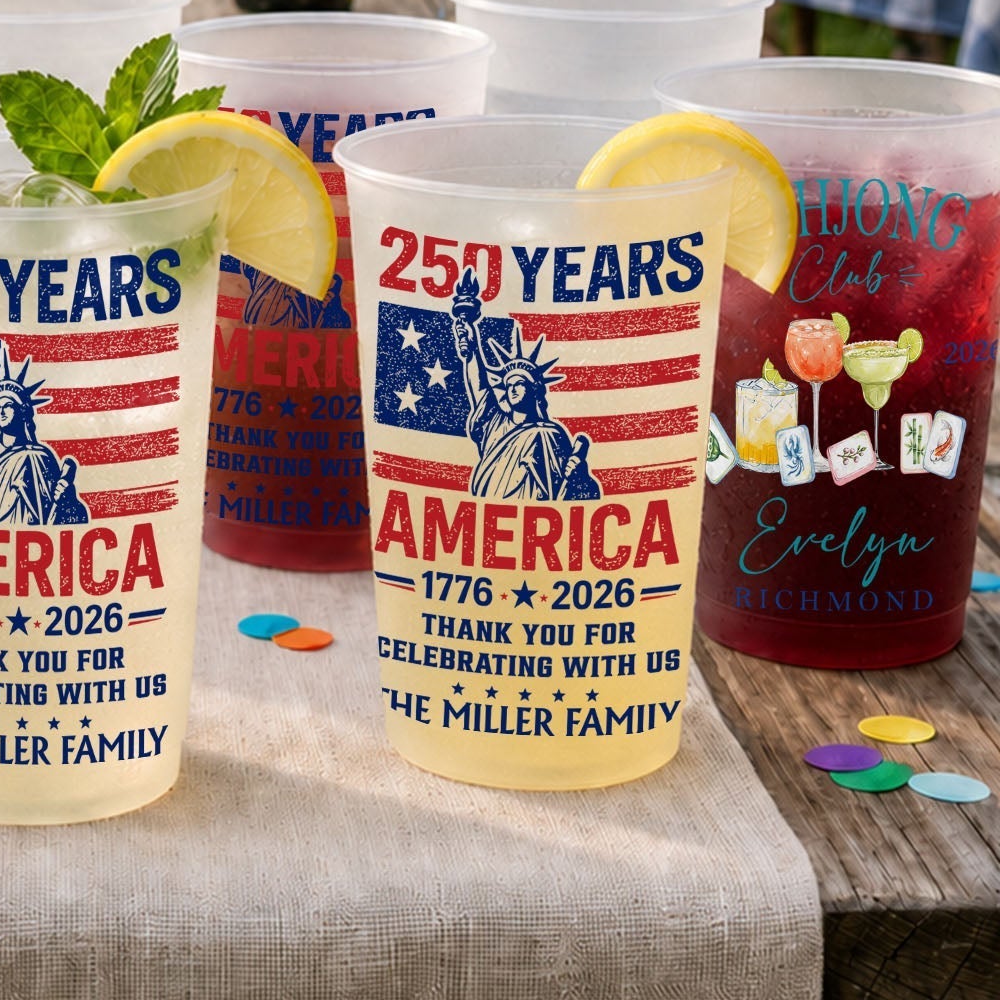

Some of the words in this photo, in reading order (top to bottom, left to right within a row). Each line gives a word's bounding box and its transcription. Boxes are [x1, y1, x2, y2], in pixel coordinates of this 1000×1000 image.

[794, 178, 971, 250] HJONG
[380, 227, 502, 301] 250
[512, 232, 703, 302] YEARS
[789, 244, 889, 303] Club
[214, 387, 262, 416] 776
[310, 395, 361, 420] 202
[287, 431, 329, 450] YOU
[338, 431, 364, 450] FO
[207, 449, 311, 477] EBRATING
[320, 457, 367, 477] WIT
[219, 494, 312, 526] MILLER
[375, 490, 679, 571] AMERICA
[739, 497, 934, 587] Evelyn
[422, 571, 492, 606] 1776
[552, 578, 634, 609] 2026
[735, 587, 933, 612] RICHMOND
[45, 603, 122, 635] 2026
[422, 613, 512, 643] THANK
[523, 624, 574, 645] YOU
[586, 622, 635, 645] FOR
[18, 651, 67, 672] YOU
[77, 647, 124, 671] FOR
[378, 636, 552, 677] CELEBRATING
[563, 654, 635, 677] WITH
[647, 650, 679, 673] US
[57, 680, 125, 704] WITH
[136, 674, 166, 698] US
[382, 688, 430, 724] HE
[443, 699, 554, 736] MILLER
[62, 725, 168, 764] FAMILY
